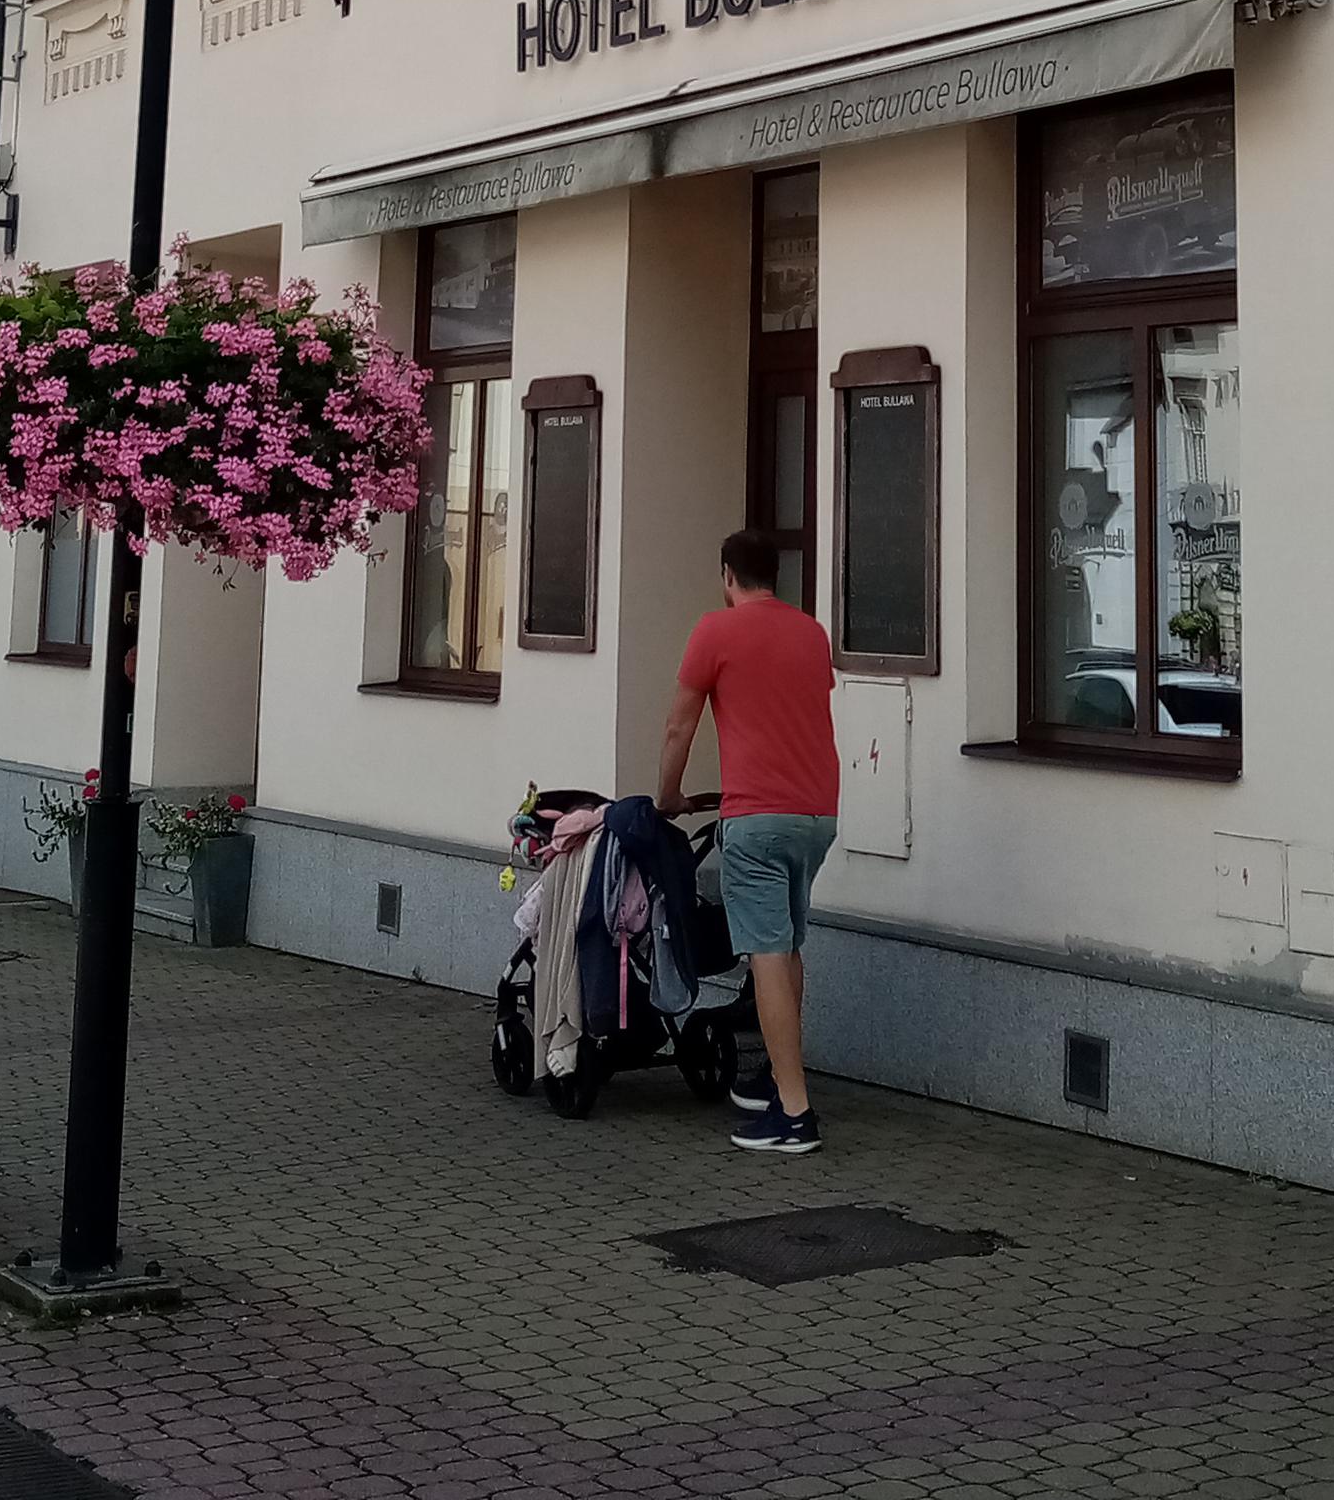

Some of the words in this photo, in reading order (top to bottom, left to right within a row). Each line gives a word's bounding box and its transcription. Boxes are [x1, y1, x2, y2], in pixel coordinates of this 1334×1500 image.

[749, 104, 805, 150] Hotel
[806, 103, 824, 138] &
[826, 80, 951, 135] Restaurace
[954, 58, 1058, 106] Bullawa
[375, 189, 413, 225] Hotel
[426, 175, 509, 217] Restaurace
[510, 160, 576, 198] Bullawa
[1106, 175, 1158, 222] Pilsner
[1157, 155, 1204, 204] Urquell
[860, 396, 882, 409] HOTEL
